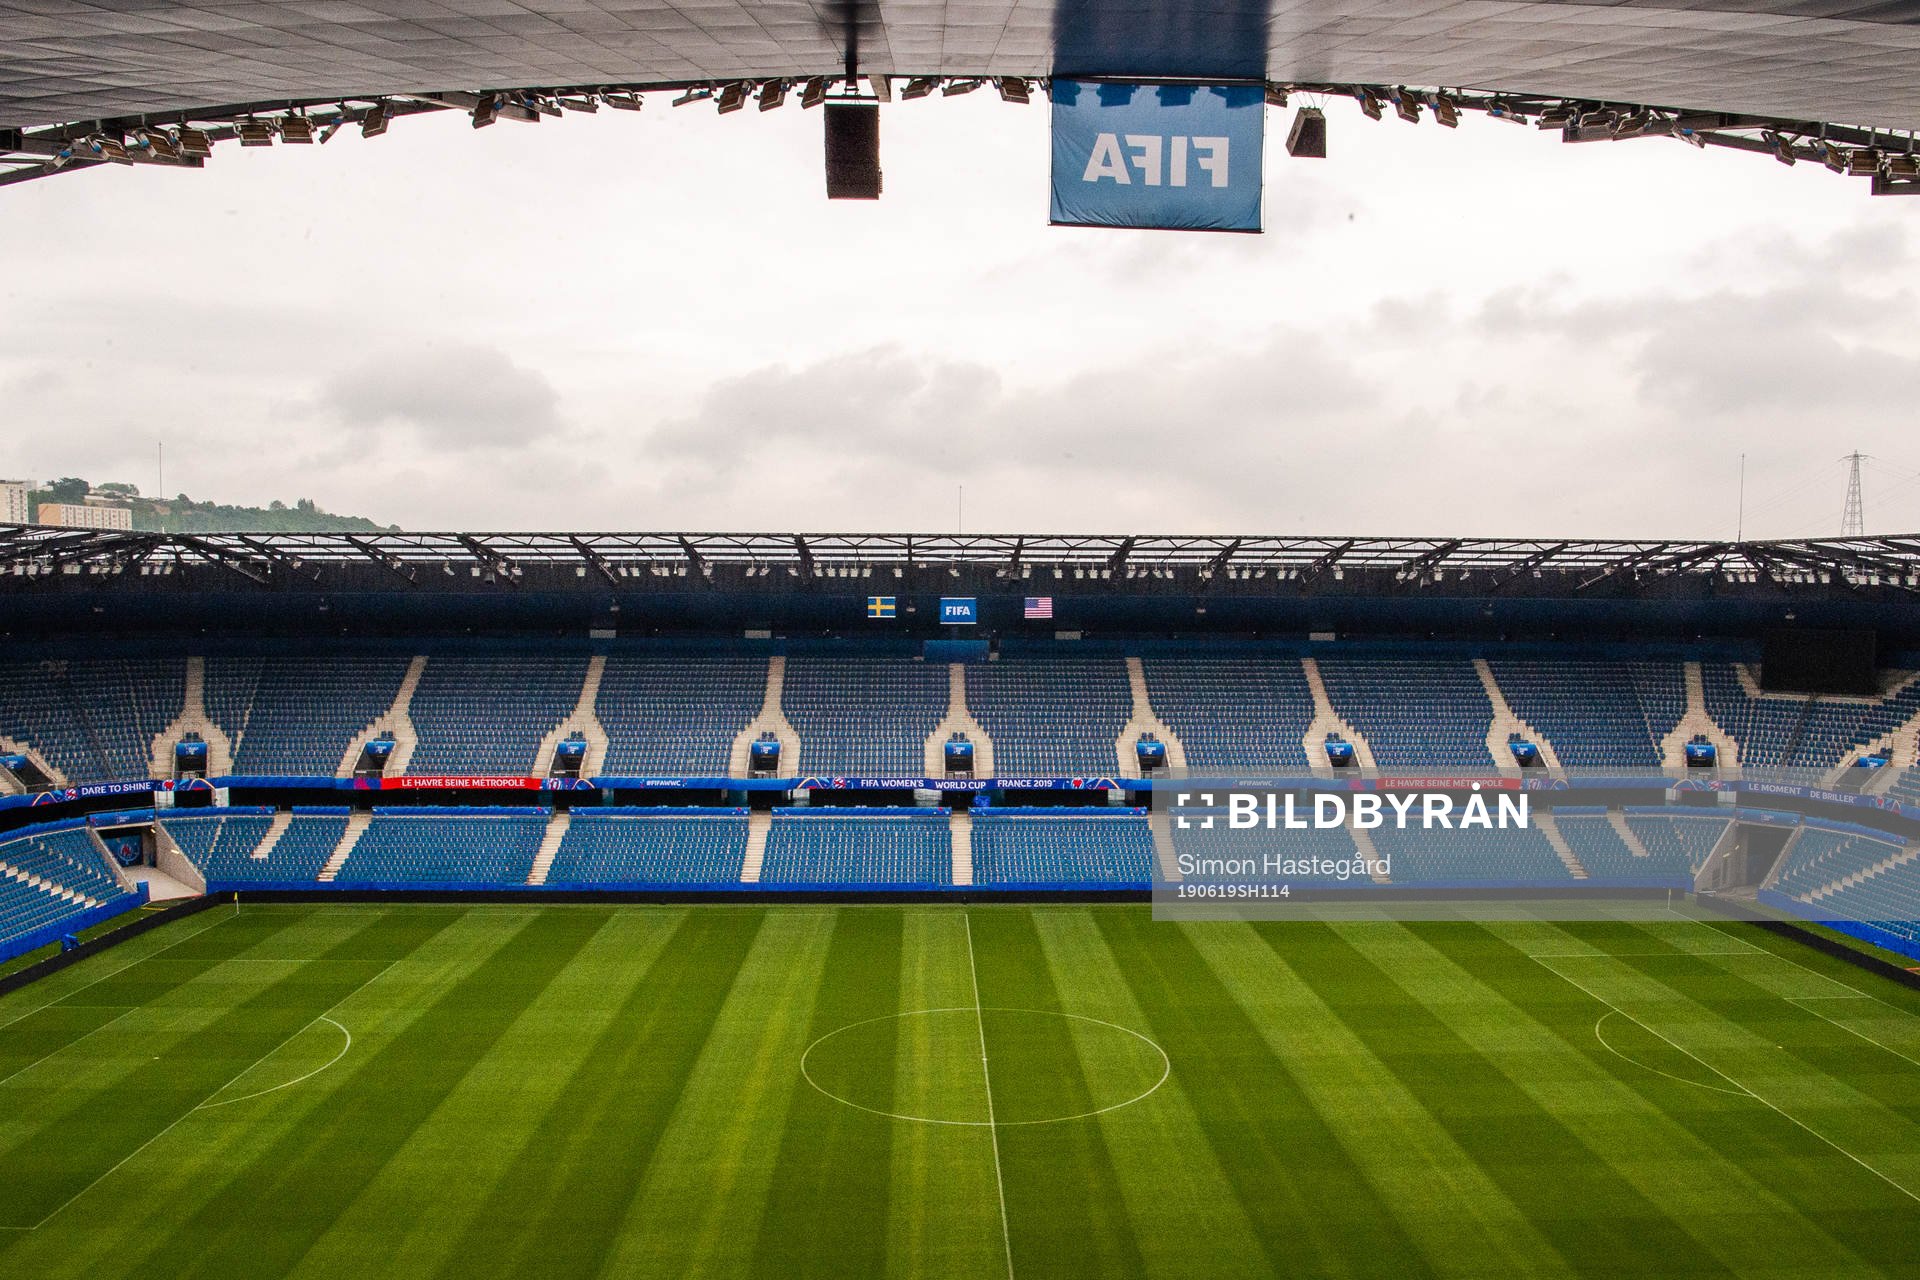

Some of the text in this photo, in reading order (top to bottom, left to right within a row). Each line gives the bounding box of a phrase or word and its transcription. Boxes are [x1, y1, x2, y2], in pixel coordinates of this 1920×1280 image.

[945, 606, 970, 616] FIFA
[402, 777, 525, 787] LE HAVRE SEINE MÉTROPOLE
[881, 780, 924, 788] WOMEN'S
[935, 781, 966, 789] WORLD
[969, 781, 986, 790] CUP
[998, 780, 1031, 788] FRANCE
[1034, 780, 1052, 788] 2019
[1386, 779, 1395, 787] LE
[1398, 779, 1425, 787] HAVRE
[1427, 779, 1450, 787] SEINE
[81, 781, 150, 796] DARE TO SHINE
[1749, 783, 1854, 803] LE MOMENT DE BRILLER
